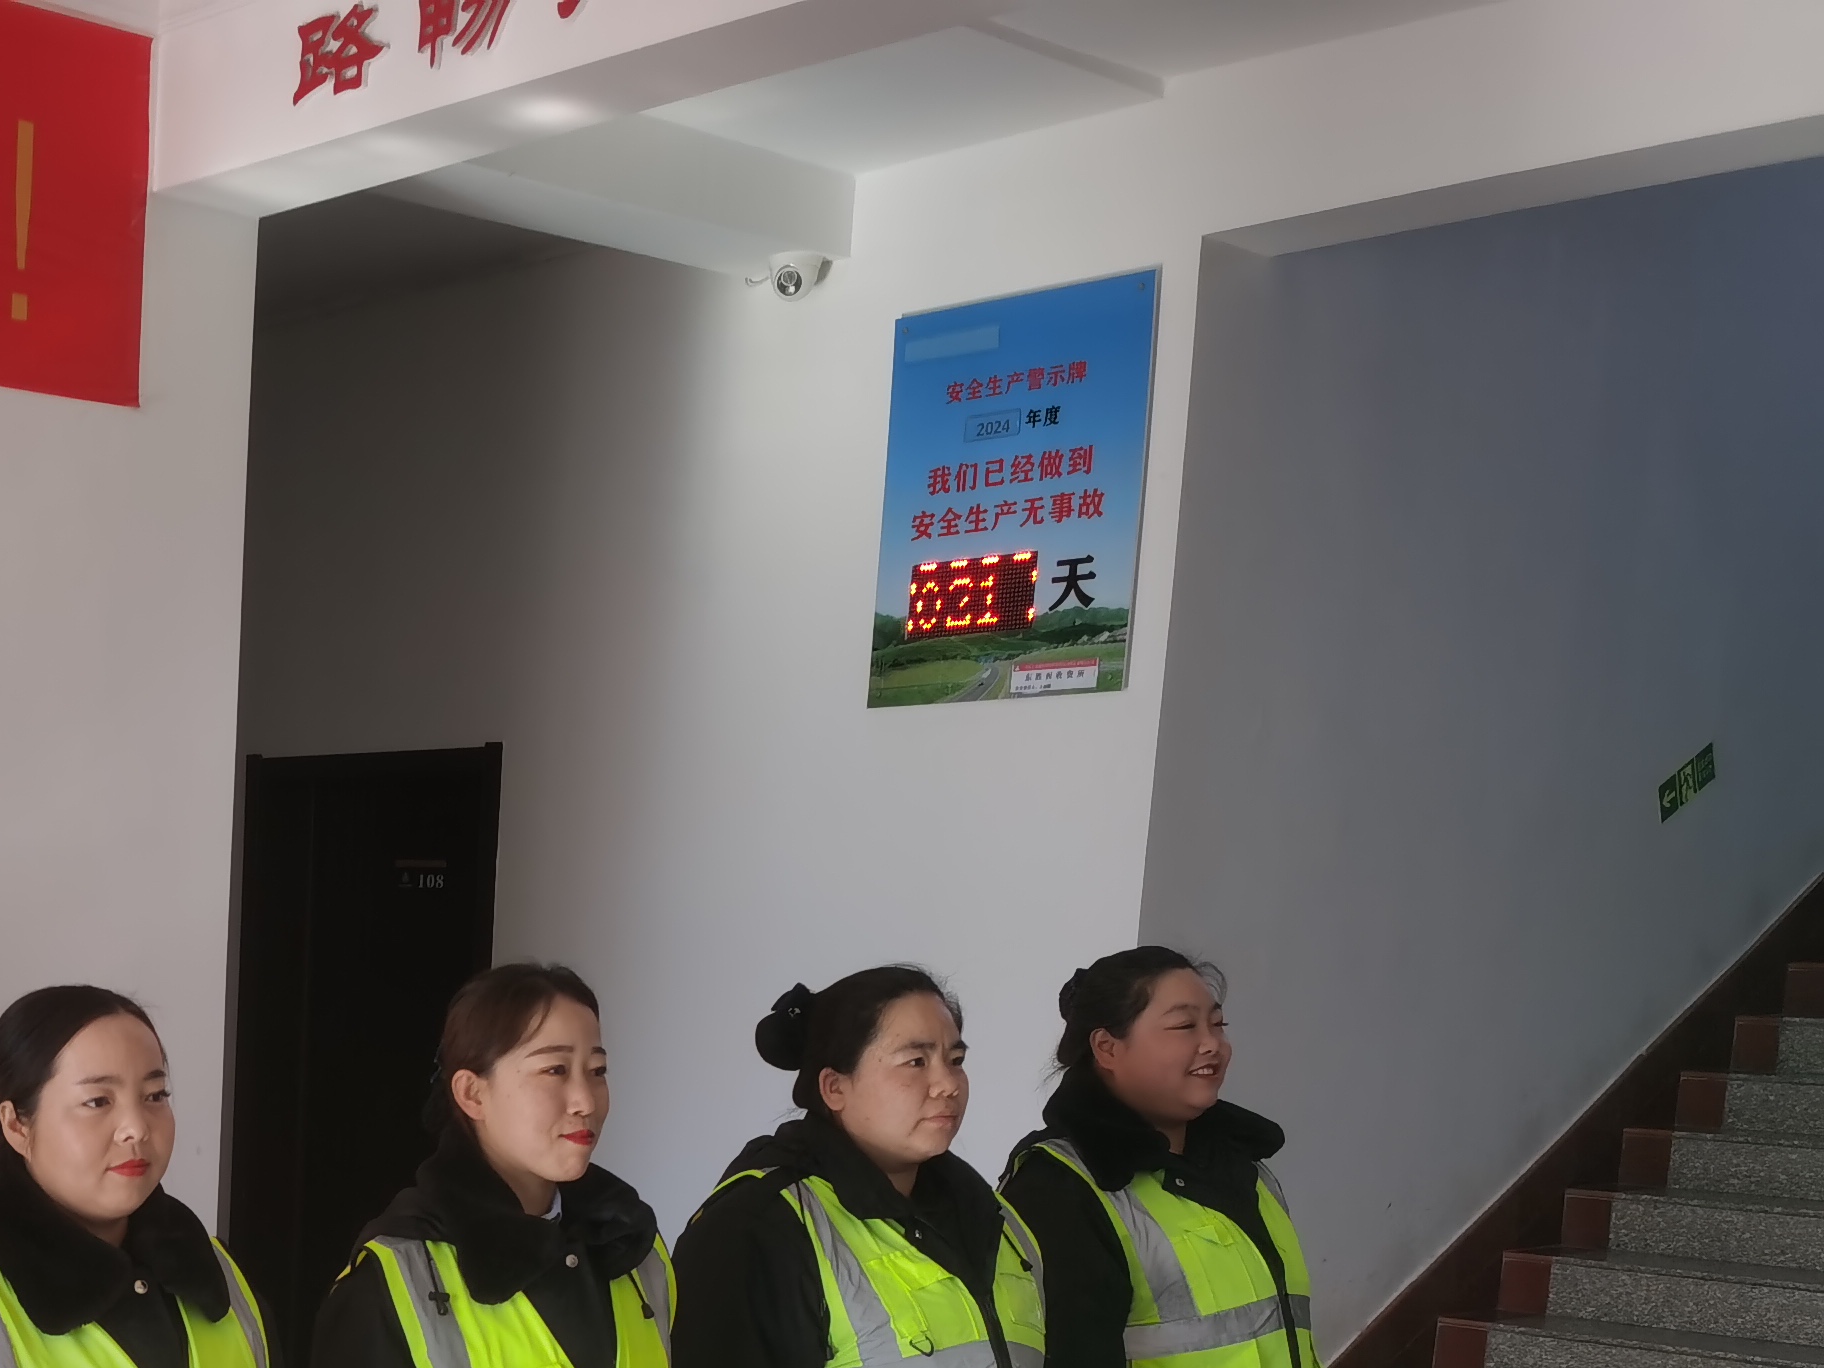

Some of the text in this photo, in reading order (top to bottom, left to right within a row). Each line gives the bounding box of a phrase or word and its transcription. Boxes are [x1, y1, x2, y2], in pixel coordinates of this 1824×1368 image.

[293, 0, 580, 105] 路畅
[946, 361, 1087, 403] 安全生产警示牌
[976, 405, 1061, 438] 2024 年度
[927, 445, 1094, 496] 我们已经做到
[911, 489, 1105, 542] 安全生产无事故
[1049, 554, 1096, 611] 天
[418, 874, 444, 888] 108
